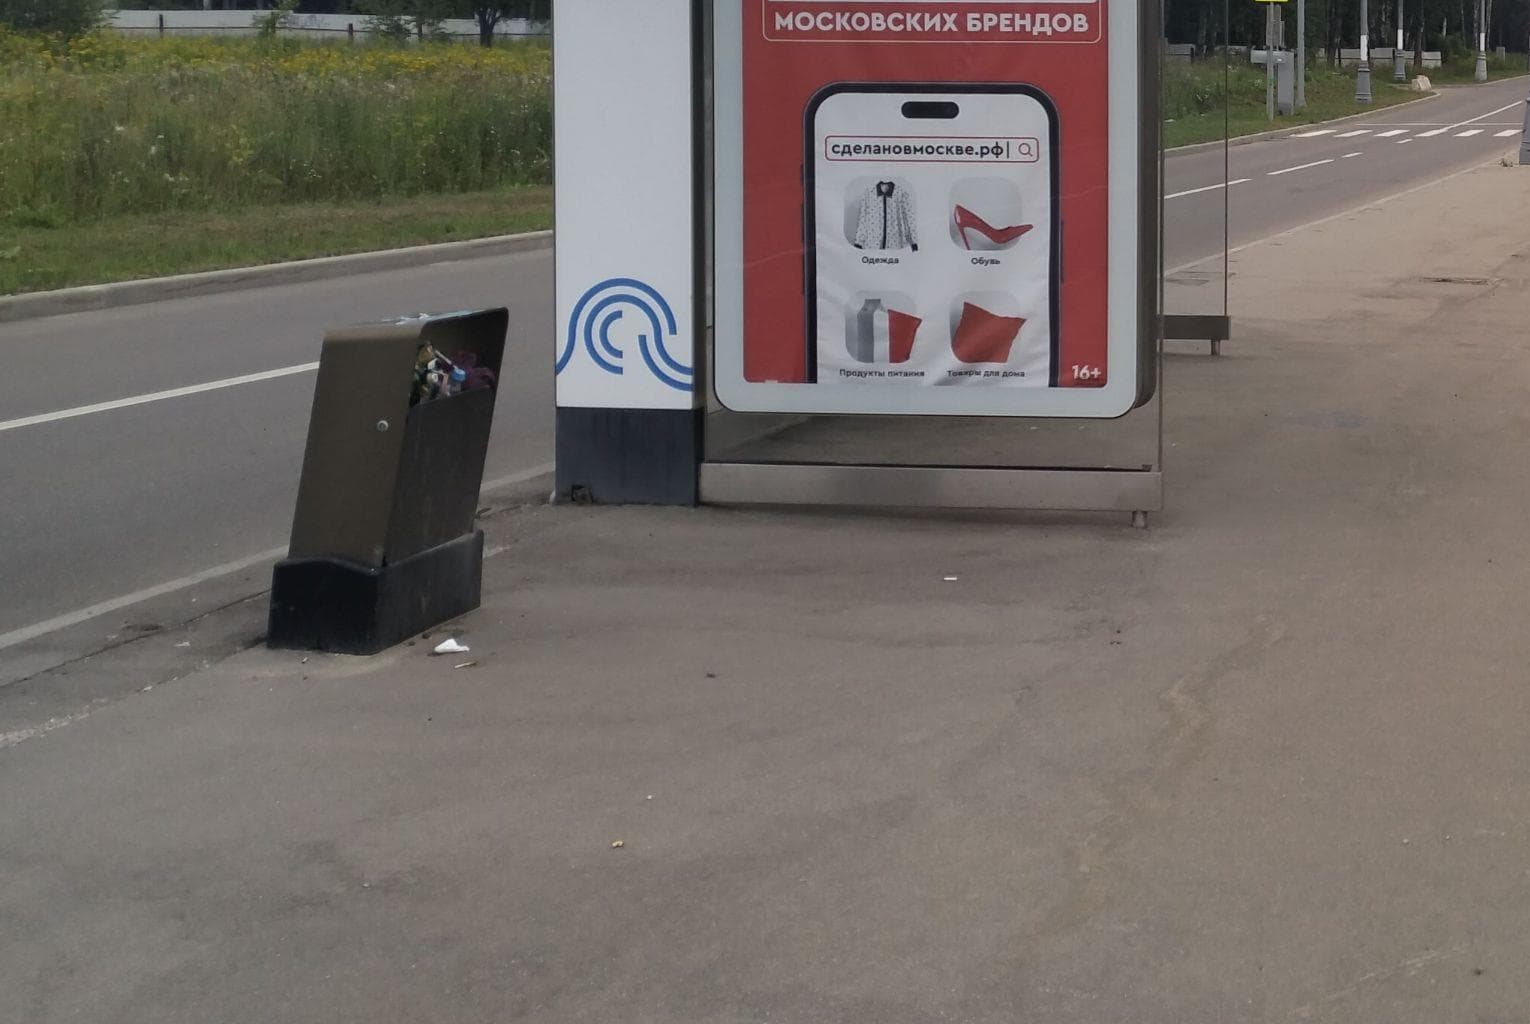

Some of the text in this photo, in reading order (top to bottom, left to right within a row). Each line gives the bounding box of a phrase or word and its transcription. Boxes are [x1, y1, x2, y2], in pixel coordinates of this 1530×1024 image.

[774, 11, 1089, 36] МОСКОВСКИХ БРЕНДОВ
[831, 141, 1004, 159] сделановмоскве.рф
[861, 256, 899, 265] Одежда
[970, 257, 1000, 266] Обувь
[839, 368, 925, 378] Продукты питания
[946, 369, 981, 378] Товары
[1002, 370, 1025, 378] дома
[1071, 364, 1102, 381] 16+
